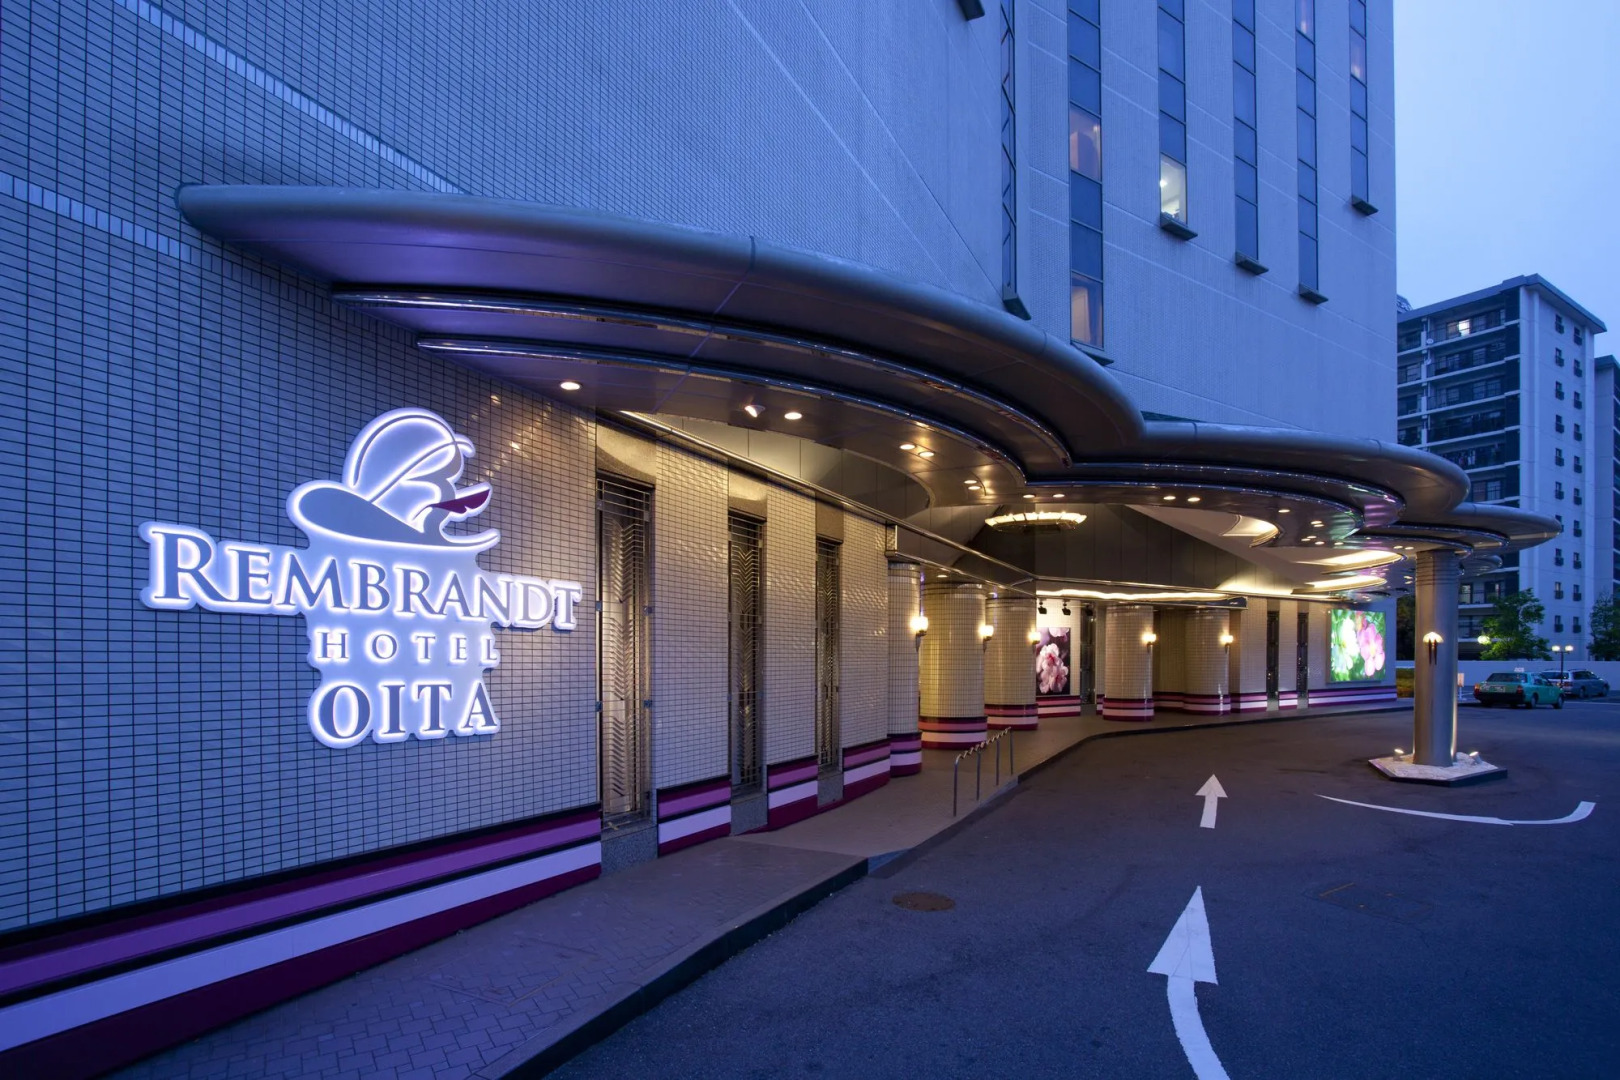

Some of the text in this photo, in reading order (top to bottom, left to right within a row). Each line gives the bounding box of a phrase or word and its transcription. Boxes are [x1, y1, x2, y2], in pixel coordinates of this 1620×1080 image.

[151, 530, 582, 625] REMBRANDT
[317, 632, 498, 662] HOTEL
[318, 681, 499, 740] OITA
